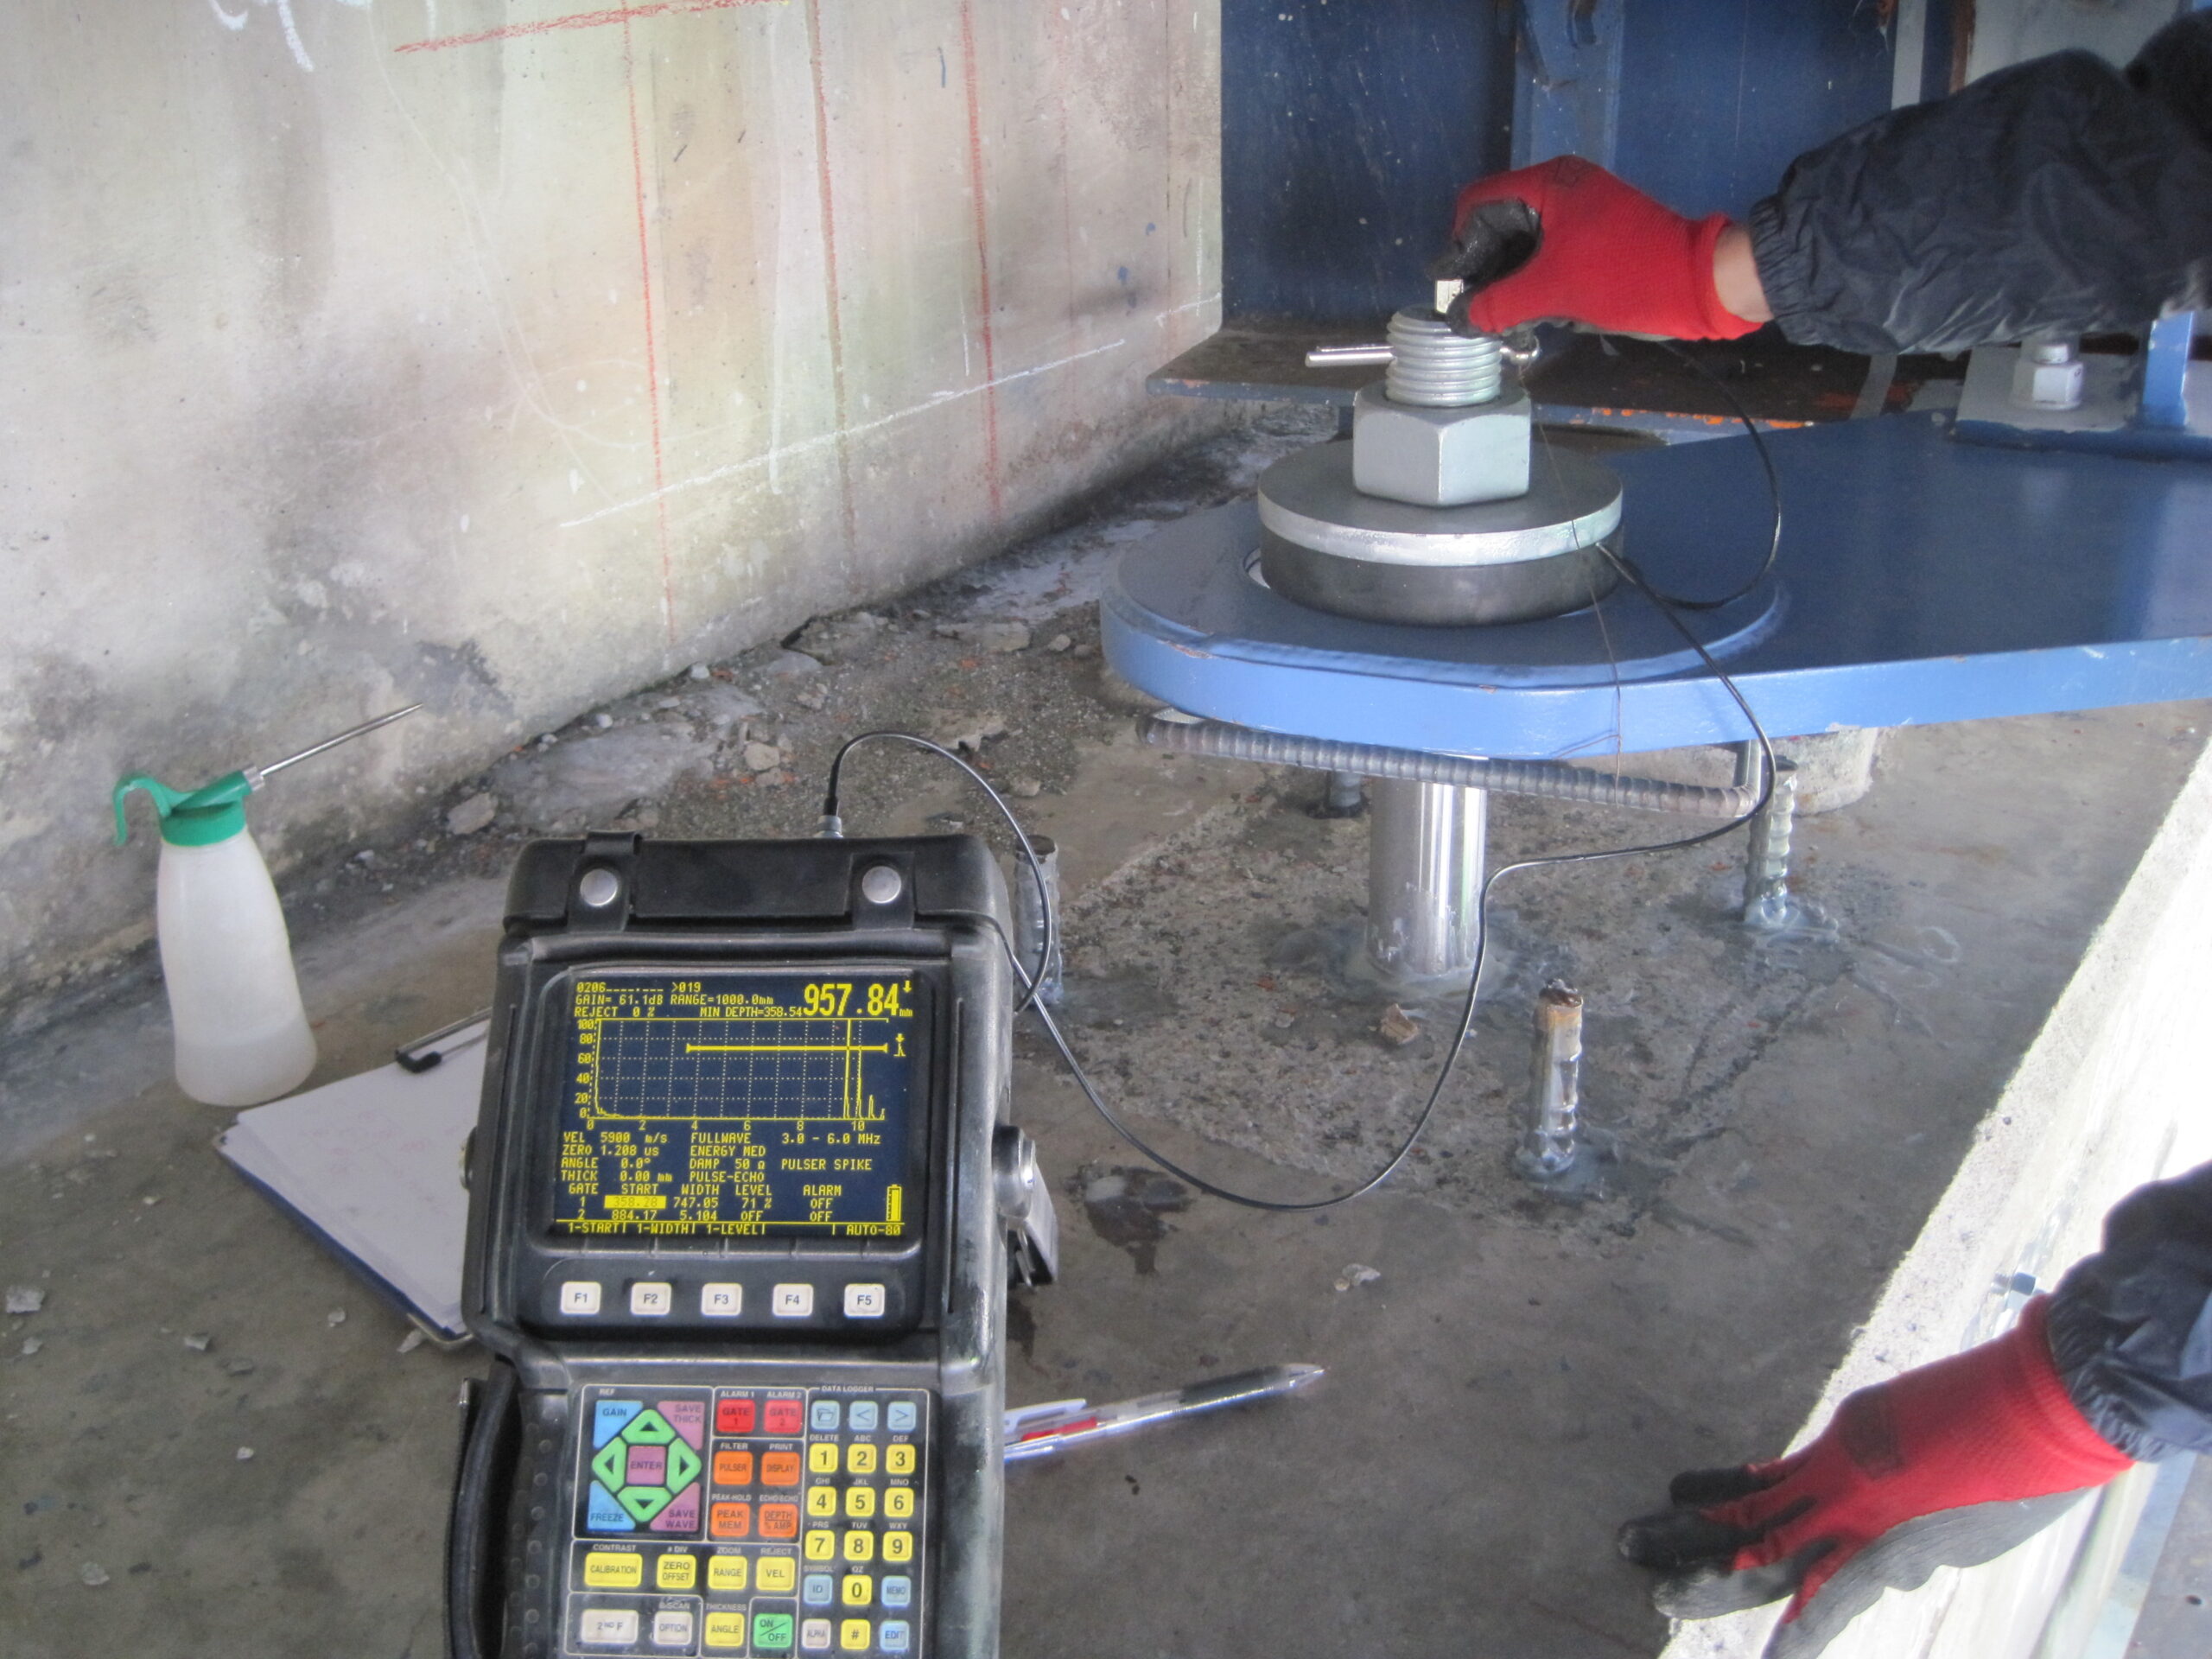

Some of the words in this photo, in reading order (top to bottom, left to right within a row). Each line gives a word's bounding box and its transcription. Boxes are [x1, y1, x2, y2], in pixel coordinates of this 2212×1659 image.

[619, 995, 664, 1005] 61.1dB
[804, 983, 899, 1016] 957.84
[899, 1008, 913, 1017] mm
[575, 1007, 619, 1017] REJECT
[700, 1007, 720, 1017] MIN
[577, 1020, 594, 1029] 100
[580, 1033, 593, 1044] 80
[578, 1053, 592, 1064] 60
[576, 1073, 590, 1084] 40
[575, 1093, 588, 1103] 20
[639, 1120, 646, 1130] 2
[691, 1120, 698, 1130] 4
[743, 1121, 751, 1131] 6
[797, 1121, 804, 1131] 8
[851, 1121, 865, 1131] 10
[564, 1132, 585, 1142] VEL
[601, 1132, 631, 1142] 5900
[645, 1133, 667, 1143] m/s
[691, 1132, 751, 1143] FULLWAVE
[782, 1133, 804, 1144] 3.0
[827, 1133, 850, 1144] 6.0
[858, 1134, 881, 1144] MHz
[563, 1145, 592, 1155] ZERO
[601, 1145, 637, 1156] 1.208
[690, 1146, 735, 1156] ENERGY
[743, 1146, 766, 1156] MED
[562, 1158, 598, 1168] ANGLE
[690, 1158, 719, 1169] DAMP
[735, 1159, 750, 1169] 50
[781, 1159, 826, 1170] PULSER
[834, 1160, 873, 1170] SPIKE
[562, 1171, 598, 1181] THICK
[620, 1171, 650, 1182] 0.00
[658, 1173, 672, 1182] mm
[690, 1171, 765, 1182] PULSE-ECHO
[569, 1184, 598, 1194] GATE
[621, 1184, 658, 1195] START
[681, 1185, 719, 1195] WIDTH
[735, 1185, 772, 1196] LEVEL
[804, 1185, 842, 1196] ALARM
[580, 1197, 586, 1207] 1
[614, 1197, 658, 1208] 358.28
[674, 1197, 719, 1208] 747.05
[741, 1198, 756, 1209] 71
[810, 1198, 833, 1209] OFF
[578, 1210, 585, 1220] 2
[612, 1210, 657, 1221] 884.17
[680, 1211, 717, 1221] 5.104
[741, 1211, 763, 1222] OFF
[810, 1211, 833, 1222] OFF
[846, 1224, 900, 1236] AUTO-80
[574, 1293, 588, 1303] F1
[644, 1294, 658, 1304] F2
[714, 1294, 729, 1305] F3
[785, 1294, 800, 1306] F4
[856, 1294, 872, 1306] F5
[602, 1408, 626, 1417] GAIN
[675, 1404, 701, 1413] SAVE
[722, 1408, 749, 1416] GATE
[769, 1408, 796, 1417] GATE
[674, 1414, 702, 1424] THICK
[779, 1418, 785, 1427] 2
[821, 1451, 827, 1465] 1
[856, 1451, 868, 1466] 2
[895, 1452, 906, 1466] 3
[630, 1460, 663, 1470] ENTER
[719, 1463, 747, 1471] PULSER
[766, 1464, 793, 1472] DISPLAY
[817, 1494, 827, 1509] 4
[855, 1495, 866, 1510] 5
[893, 1495, 905, 1510] 6
[590, 1513, 624, 1522] FREEZE
[668, 1510, 695, 1518] SAVE
[717, 1510, 743, 1518] PEAK
[765, 1510, 791, 1520] DEPTH
[665, 1519, 696, 1529] WAVE
[774, 1521, 791, 1529] AMP
[815, 1538, 825, 1553] 7
[853, 1538, 864, 1554] 8
[892, 1539, 903, 1554] 9
[590, 1565, 637, 1573] CALIBRATION
[664, 1561, 690, 1570] ZERO
[663, 1572, 690, 1580] OFFSET
[714, 1568, 741, 1577] RANGE
[766, 1568, 785, 1578] VEL
[812, 1585, 823, 1593] ID
[852, 1582, 862, 1598] 0
[616, 1622, 623, 1630] F
[659, 1623, 687, 1632] OPTION
[760, 1619, 773, 1628] ON
[711, 1625, 739, 1634] ANGLE
[885, 1630, 905, 1639] EDIT
[768, 1632, 787, 1642] OFF
